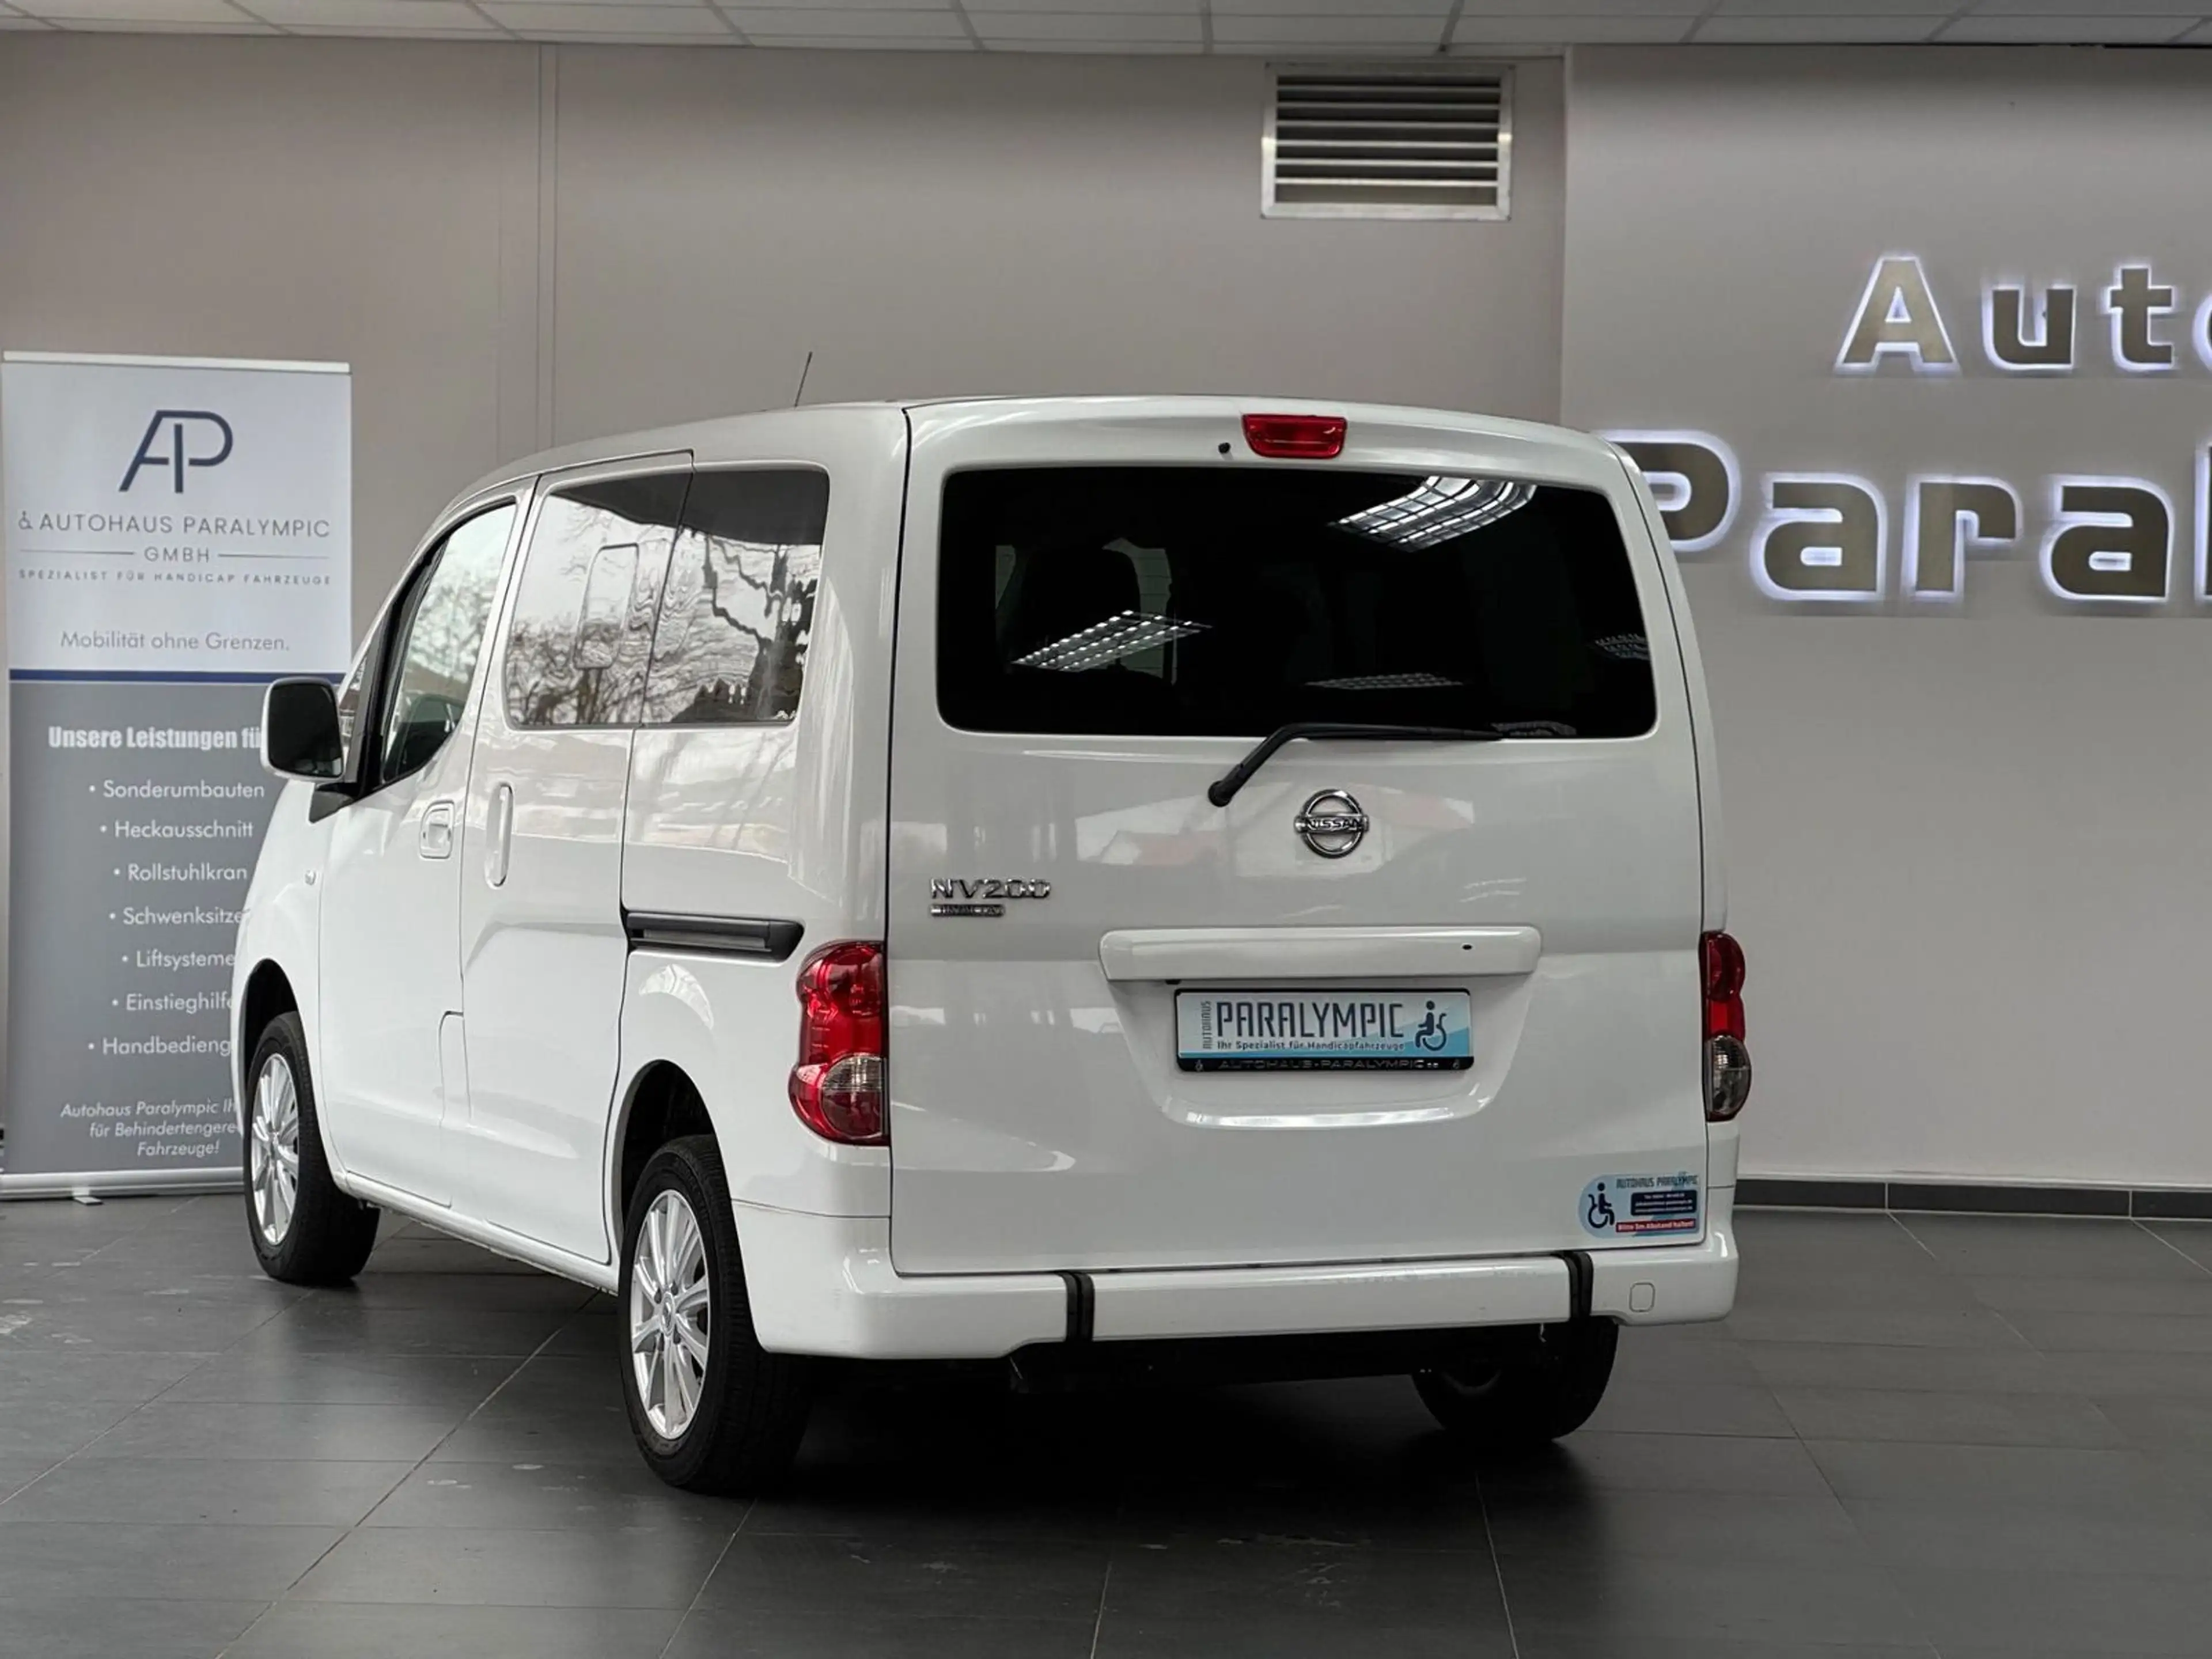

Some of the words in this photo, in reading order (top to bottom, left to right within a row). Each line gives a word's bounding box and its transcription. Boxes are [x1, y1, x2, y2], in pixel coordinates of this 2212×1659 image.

[39, 513, 173, 533] AUTOHAUS
[183, 516, 329, 538] PARALYMPIC
[1606, 437, 2212, 600] Para
[144, 547, 210, 563] GMBH
[18, 569, 107, 581] SPEZIALIST
[117, 570, 145, 582] FÜR
[154, 573, 235, 584] HANDICAP
[243, 574, 330, 585] FAHRZEUGE
[60, 630, 145, 649] Mobilität
[151, 632, 199, 650] ohne
[205, 632, 289, 651] Grenzen.
[48, 726, 122, 748] Unsere
[126, 726, 237, 751] Leistungen
[103, 779, 264, 798] Sonderumbauten
[115, 820, 253, 838] Heckausschnitt
[1307, 818, 1362, 832] NISSAN
[128, 862, 247, 881] Rollstuhlkran
[931, 878, 1050, 899] NV200
[1217, 1001, 1404, 1037] PARALYMPIC
[1236, 1041, 1285, 1050] Spezialist
[1289, 1041, 1304, 1050] für
[1308, 1041, 1404, 1051] Handicapfahrzeuge
[60, 1102, 131, 1117] Autohaus
[136, 1099, 218, 1118] Paralympic
[90, 1123, 110, 1138] für
[137, 1140, 219, 1157] Fahrzeuge!
